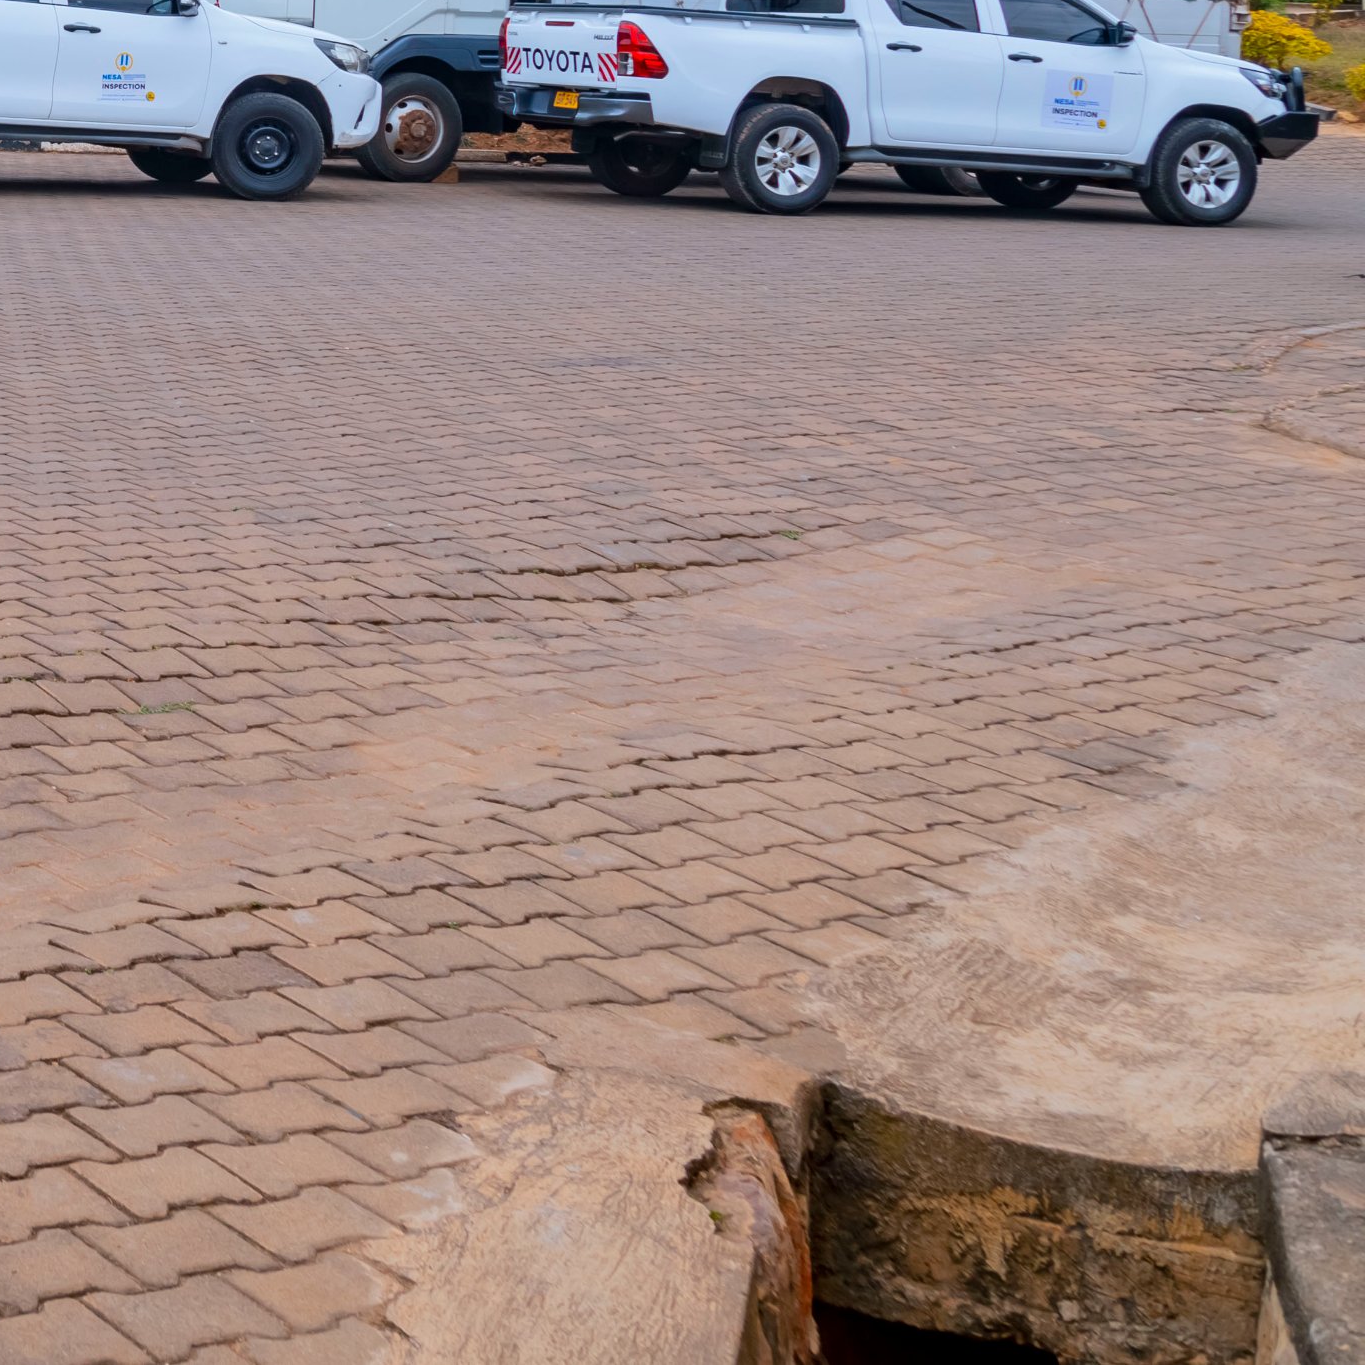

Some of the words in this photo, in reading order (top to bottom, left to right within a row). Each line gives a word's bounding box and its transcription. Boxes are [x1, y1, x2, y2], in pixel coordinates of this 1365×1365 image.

[522, 47, 594, 74] TOYOTA
[1054, 98, 1074, 106] NESA
[1052, 107, 1098, 118] INSPECTION
